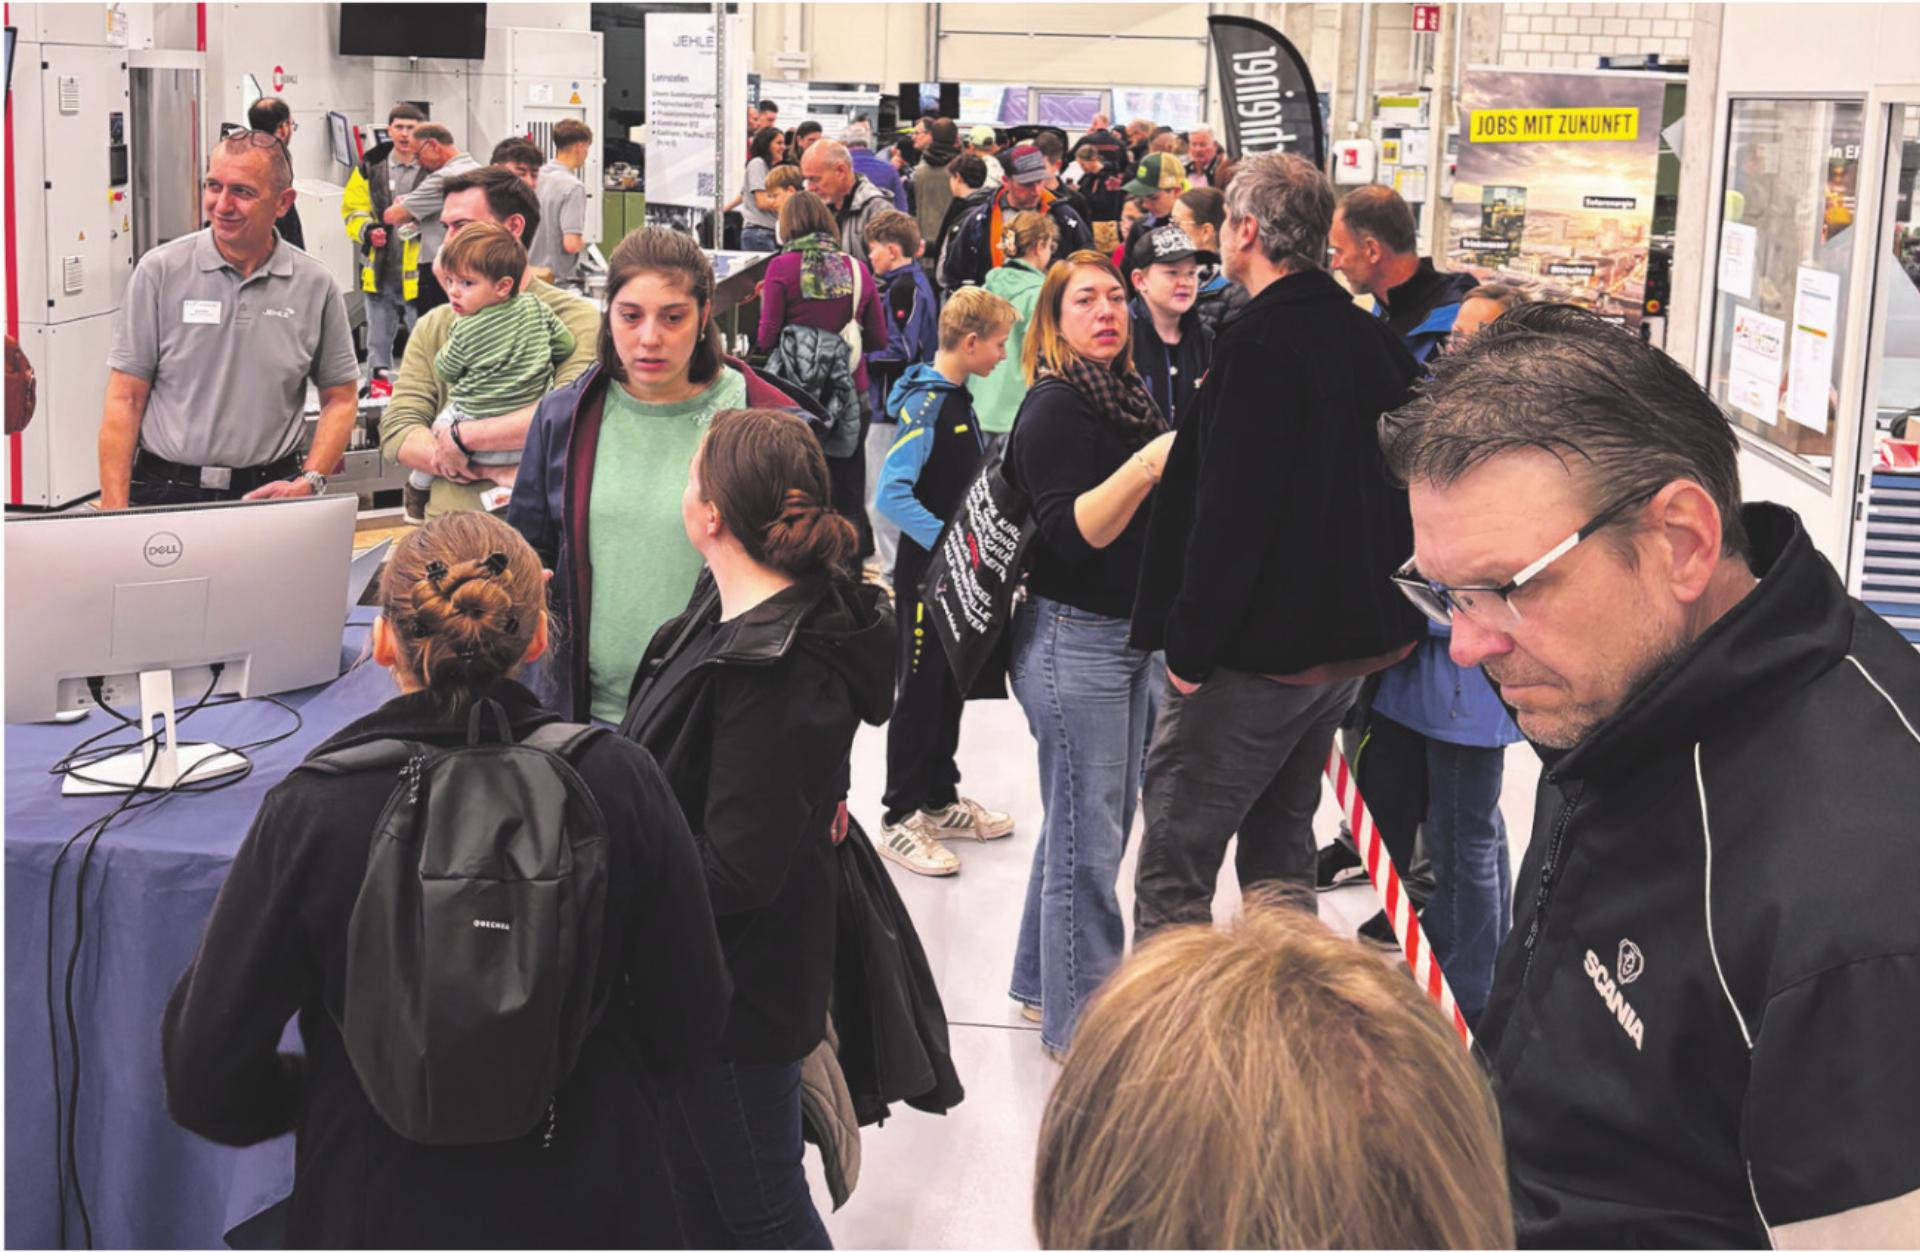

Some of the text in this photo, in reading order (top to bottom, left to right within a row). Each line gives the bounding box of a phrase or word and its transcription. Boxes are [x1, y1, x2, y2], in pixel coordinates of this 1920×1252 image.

[672, 35, 715, 48] JEHLE
[1477, 113, 1632, 136] JOBS MIT ZUKUNFT
[148, 544, 179, 556] DELL
[1583, 948, 1645, 1052] SCANIA
